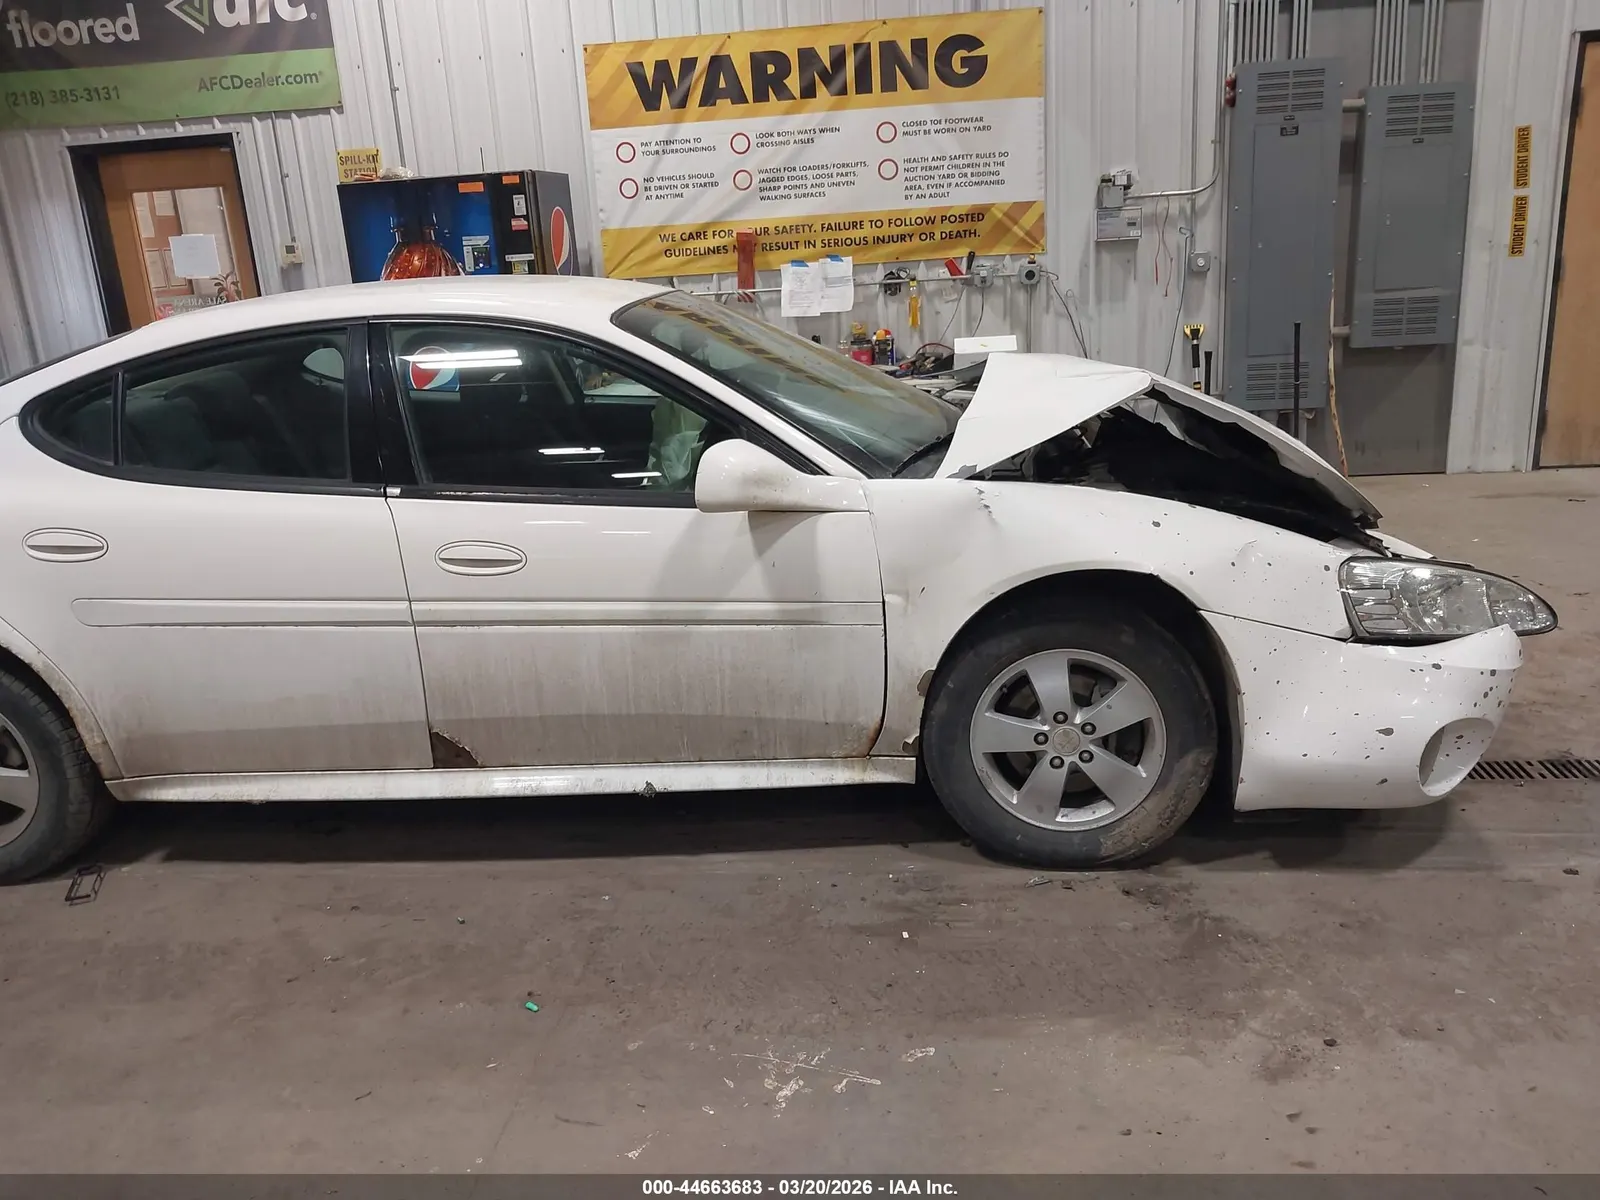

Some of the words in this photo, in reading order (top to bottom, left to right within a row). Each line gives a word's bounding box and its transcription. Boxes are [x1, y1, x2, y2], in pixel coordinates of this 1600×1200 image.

[6, 3, 140, 48] floored
[626, 34, 988, 112] WARNING
[6, 90, 44, 108] (218)
[50, 85, 120, 103] 385-3131
[902, 119, 927, 127] CLOSED
[944, 116, 984, 125] FOOTWEAR
[662, 145, 716, 155] SURROUNDINGS
[756, 140, 790, 148] CROSSING
[1517, 126, 1530, 153] DRIVER
[947, 162, 980, 170] CHILDREN
[1516, 156, 1529, 187] STUDENT
[954, 179, 1005, 188] ACCOMPANIED
[759, 194, 792, 202] WALKING
[1514, 196, 1527, 222] DRIVER
[659, 233, 676, 243] WE
[680, 231, 708, 242] CARE
[712, 229, 734, 239] FOR
[774, 224, 817, 235] SAFETY.
[821, 220, 865, 232] FAILURE
[869, 219, 884, 229] TO
[888, 215, 936, 227] FOLLOW
[940, 213, 985, 224] POSTED
[1511, 224, 1524, 255] STUDENT
[664, 245, 729, 258] GUIDELINES
[761, 240, 800, 252] RESULT
[804, 240, 816, 249] IN
[820, 236, 868, 248] SERIOUS
[872, 233, 914, 245] INJURY
[919, 232, 935, 242] OR
[940, 229, 980, 240] DEATH.
